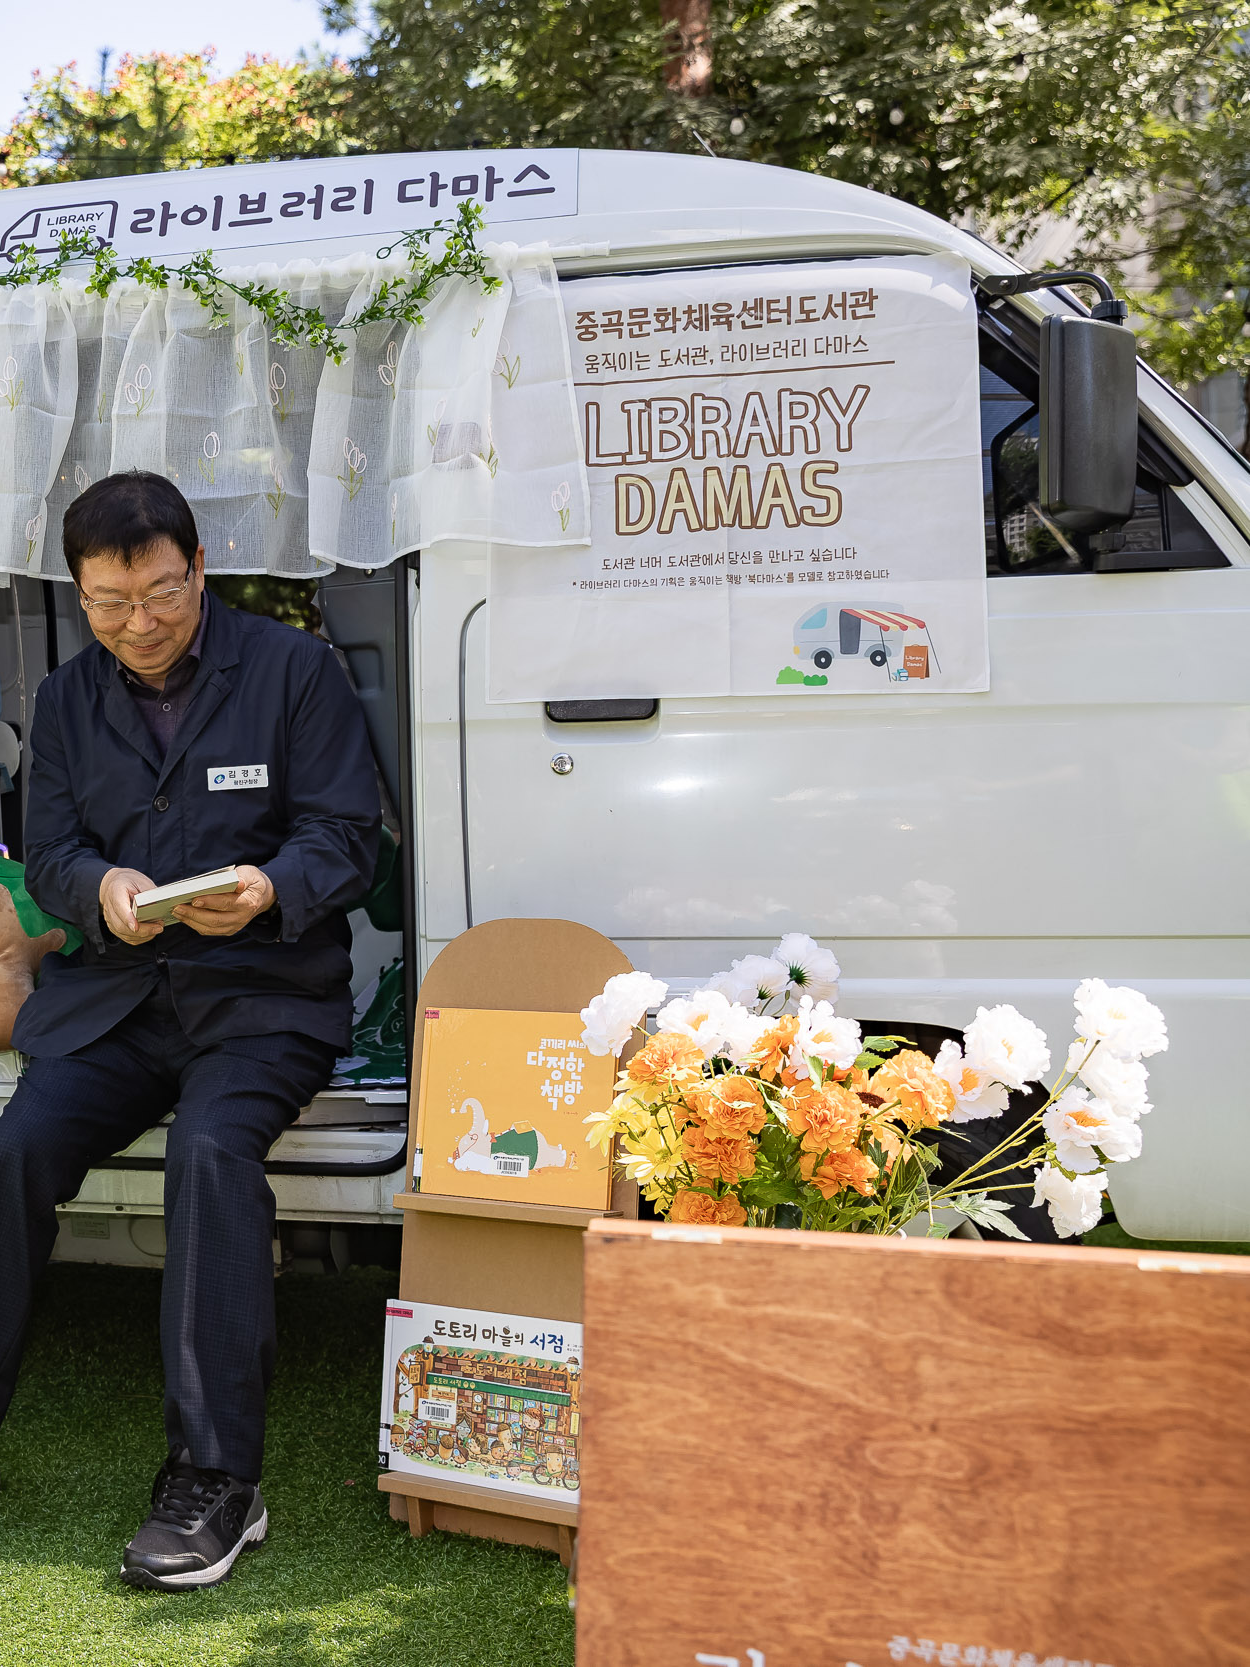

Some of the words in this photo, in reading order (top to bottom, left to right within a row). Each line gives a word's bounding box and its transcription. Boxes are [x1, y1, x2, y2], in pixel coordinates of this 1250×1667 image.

[131, 178, 374, 237] 라이브러리
[397, 164, 556, 208] 다마스
[46, 211, 104, 228] LIBRARY
[50, 224, 97, 238] DAMAS
[574, 288, 879, 341] 중곡문화체육센터도서관
[584, 349, 651, 374] 움직이는
[657, 345, 715, 370] 도서관,
[720, 338, 808, 365] 라이브러리
[814, 334, 869, 357] 다마스
[585, 384, 870, 467] LIBRARY
[615, 460, 842, 536] DAMAS
[601, 557, 635, 571] 도서관
[640, 556, 662, 569] 너머
[666, 554, 726, 569] 도서관에서
[728, 551, 763, 566] 당신을
[768, 549, 805, 564] 만나고
[809, 547, 857, 562] 싶습니다
[580, 578, 621, 590] 라이브러리
[623, 577, 658, 589] 다마스의
[688, 575, 723, 587] 움직이는
[725, 573, 742, 585] 책방
[797, 570, 824, 582] 모델로
[827, 569, 890, 581] 참고하였습니다
[527, 1051, 585, 1080] 다정한
[540, 1080, 584, 1111] 책방
[432, 1319, 477, 1341] 도토리
[481, 1325, 524, 1347] 마을의
[529, 1333, 564, 1353] 서점
